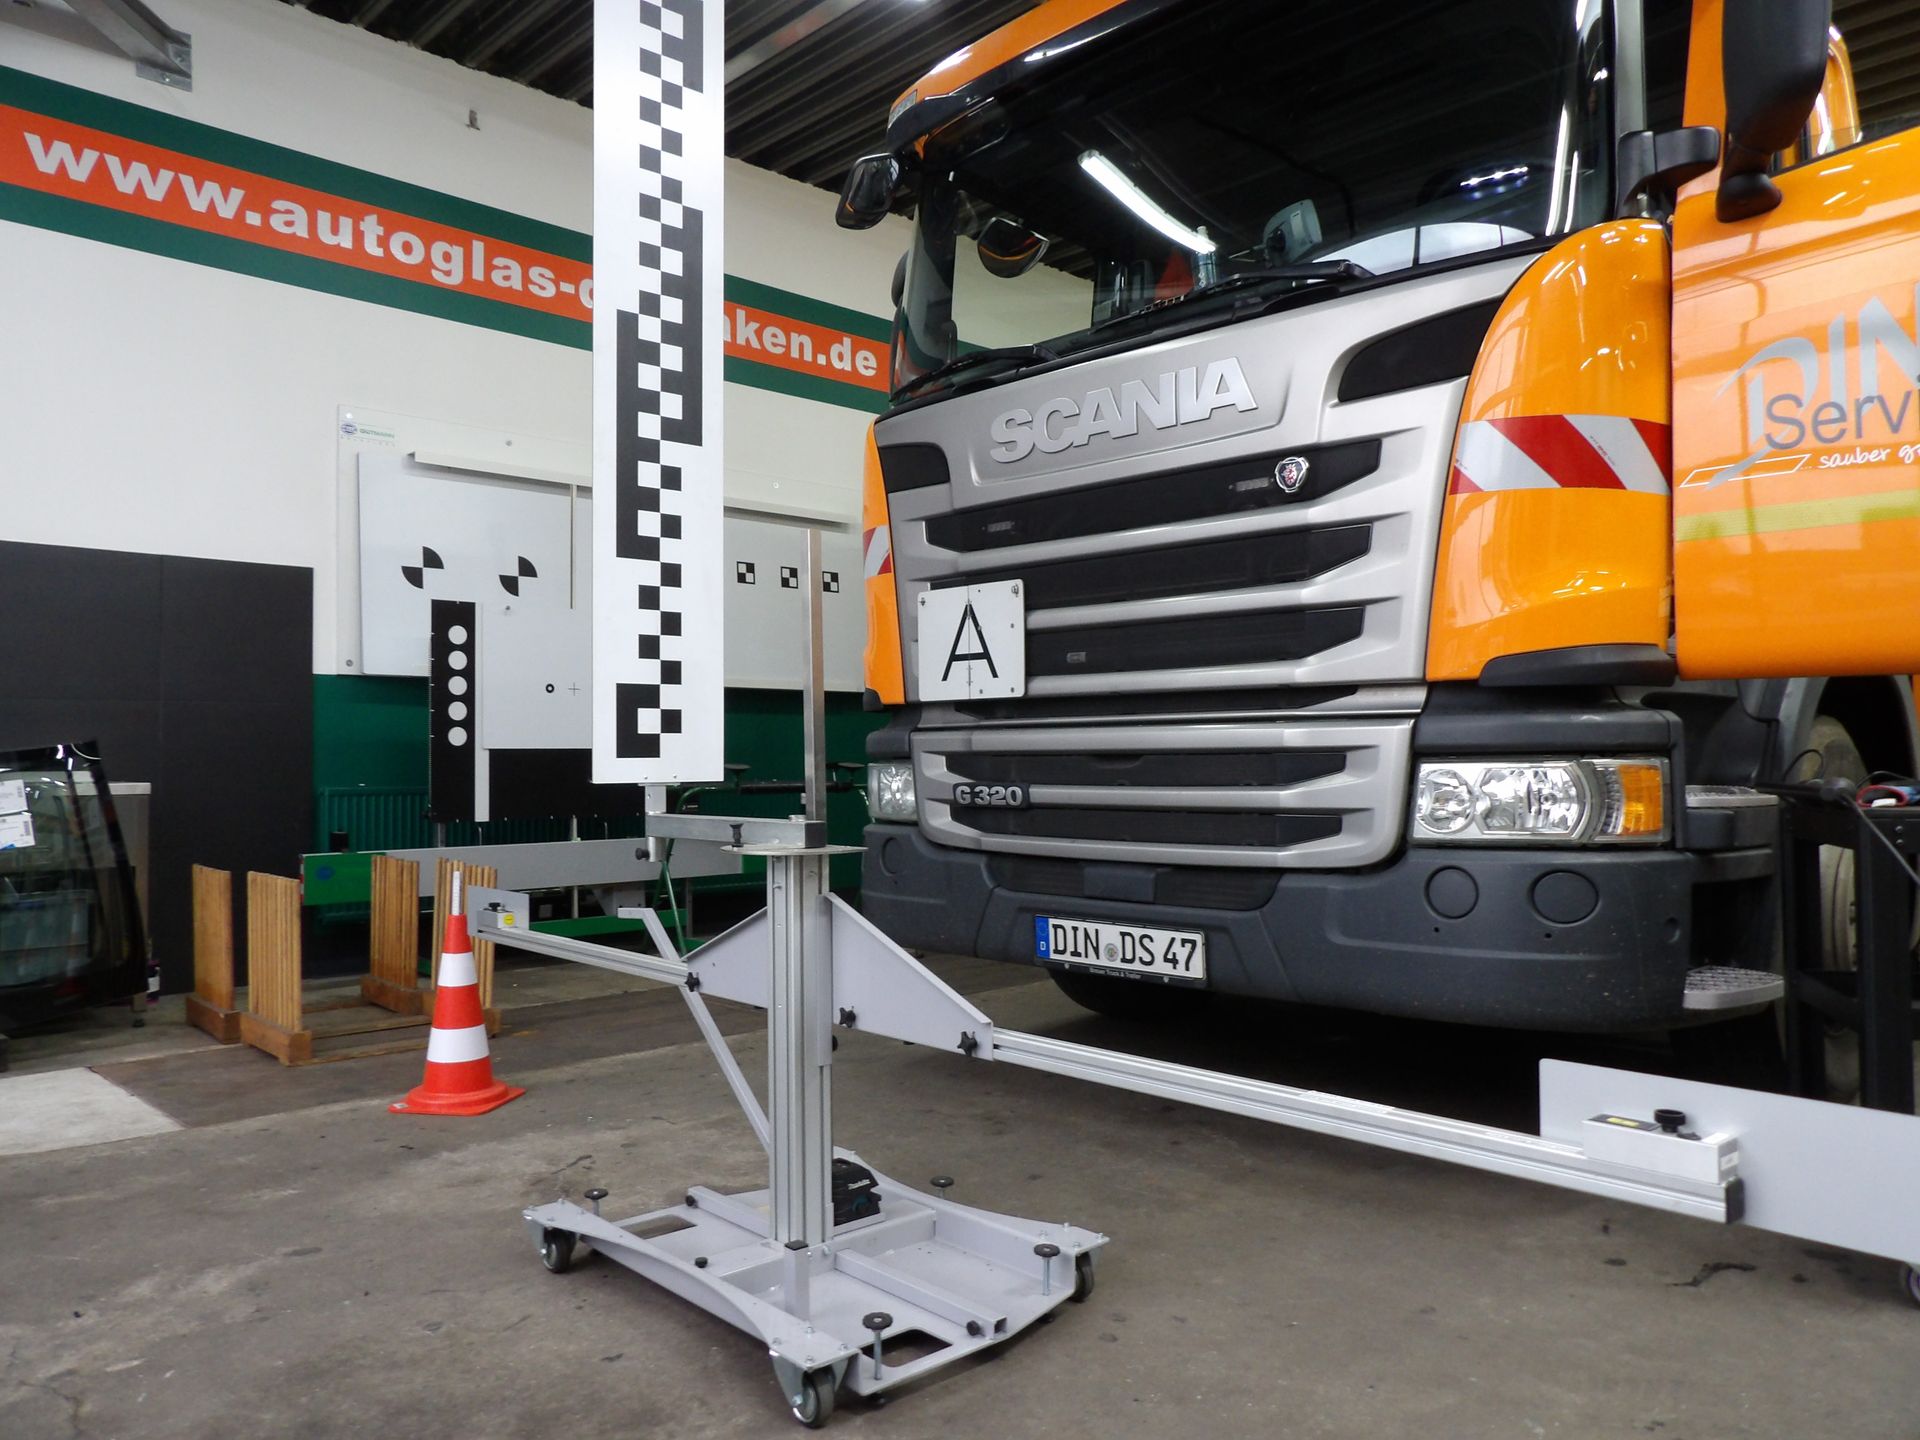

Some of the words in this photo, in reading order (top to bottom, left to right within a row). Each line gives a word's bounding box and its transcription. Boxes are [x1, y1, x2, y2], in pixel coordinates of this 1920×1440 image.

[989, 356, 1259, 463] SCANIA
[1764, 374, 1920, 450] Serv
[1818, 446, 1891, 469] sauber
[941, 602, 999, 682] A
[955, 785, 972, 805] G
[974, 785, 1023, 806] 320
[1051, 923, 1100, 960] DIN
[1119, 931, 1155, 967] DS
[1163, 937, 1197, 972] 47
